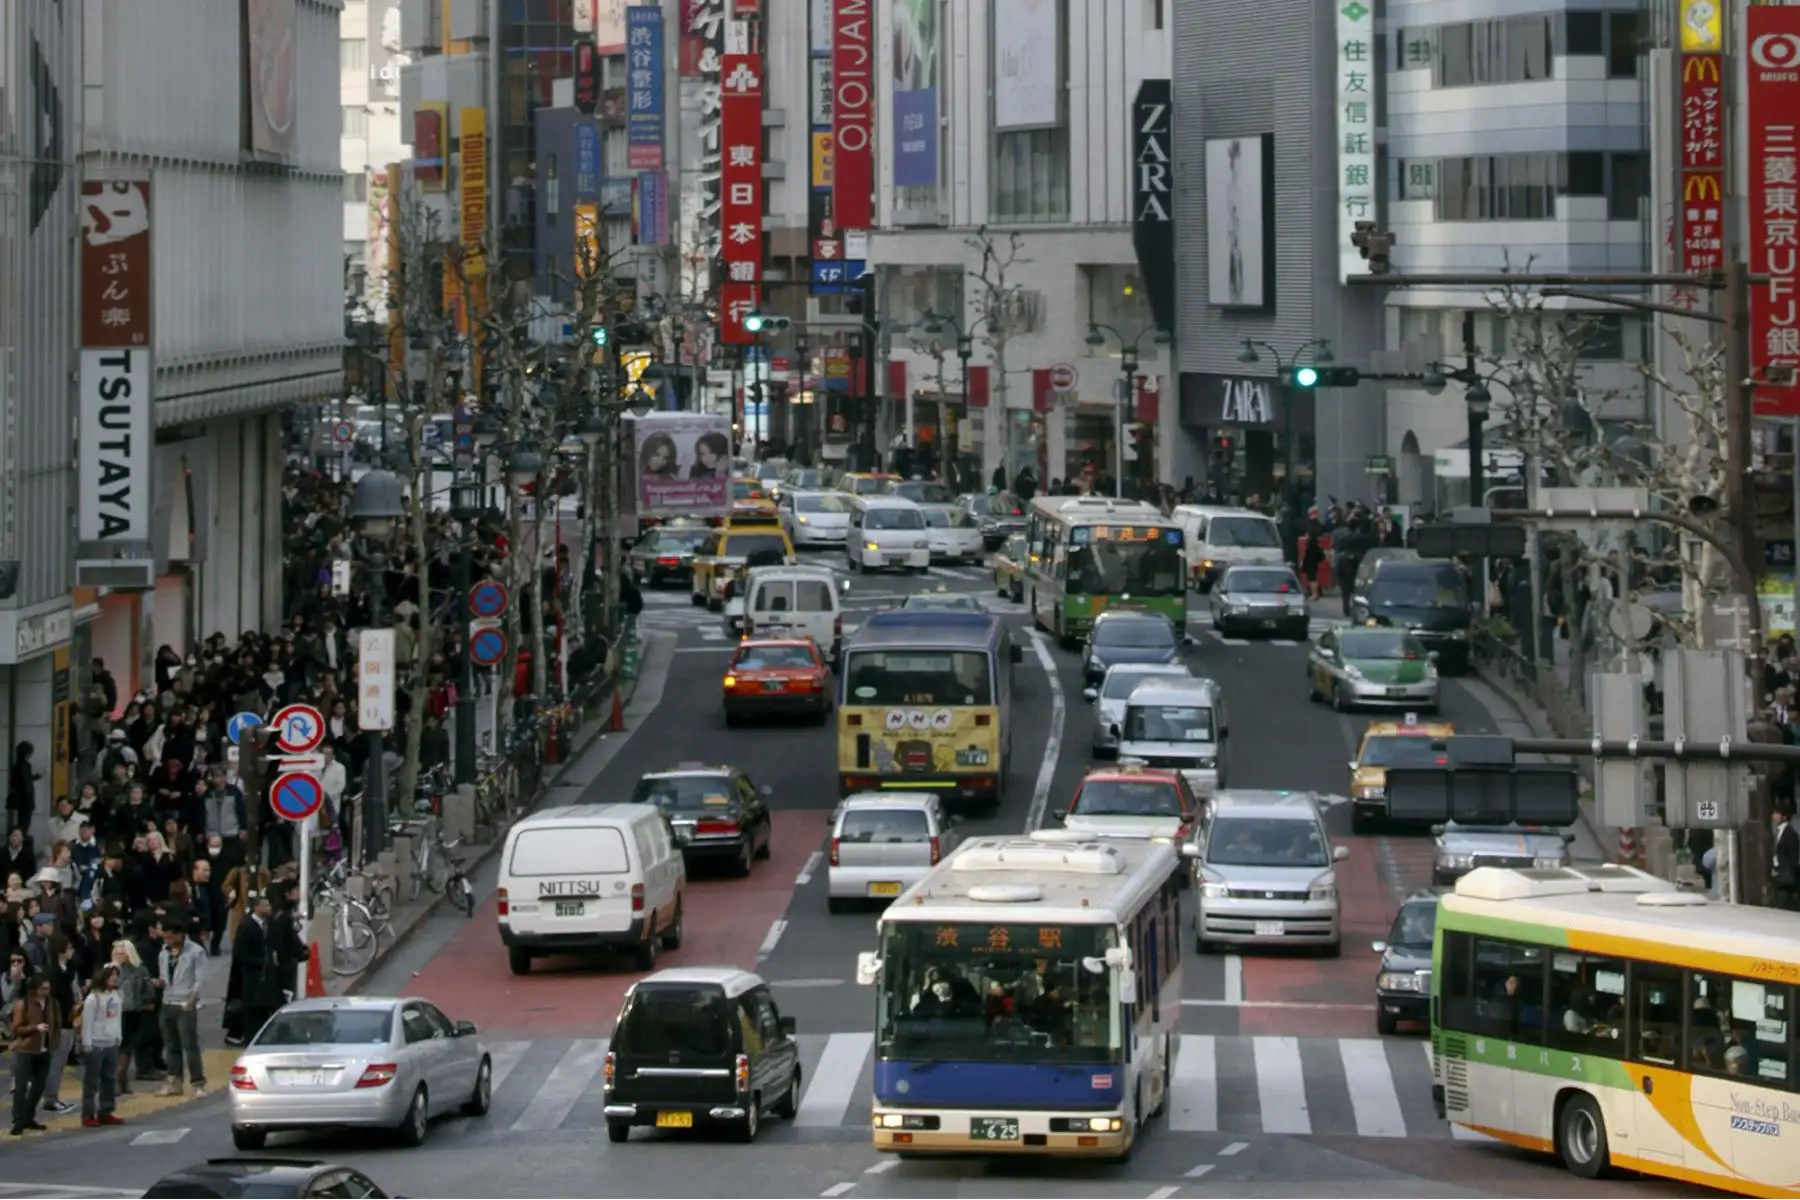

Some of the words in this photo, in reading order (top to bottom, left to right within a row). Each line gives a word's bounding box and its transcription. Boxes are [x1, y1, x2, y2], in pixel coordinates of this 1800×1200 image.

[631, 26, 653, 110] 渋谷整形
[463, 132, 484, 182] TOWER
[1344, 39, 1370, 218] 住友信託銀行
[1684, 96, 1701, 164] ハンバーガー
[1701, 87, 1719, 161] マクドナルド
[1137, 103, 1170, 222] ZARA
[463, 186, 484, 249] RECORD
[728, 144, 755, 324] 東日本銀行
[101, 252, 131, 327] ぶん楽
[1221, 379, 1274, 423] ZARA
[98, 349, 131, 540] TSUTAYA
[538, 880, 601, 894] NITTSU
[935, 926, 1062, 949] 渋谷駅
[1729, 1090, 1780, 1120] Non-Step
[1732, 1117, 1779, 1136] ノンステップバス
